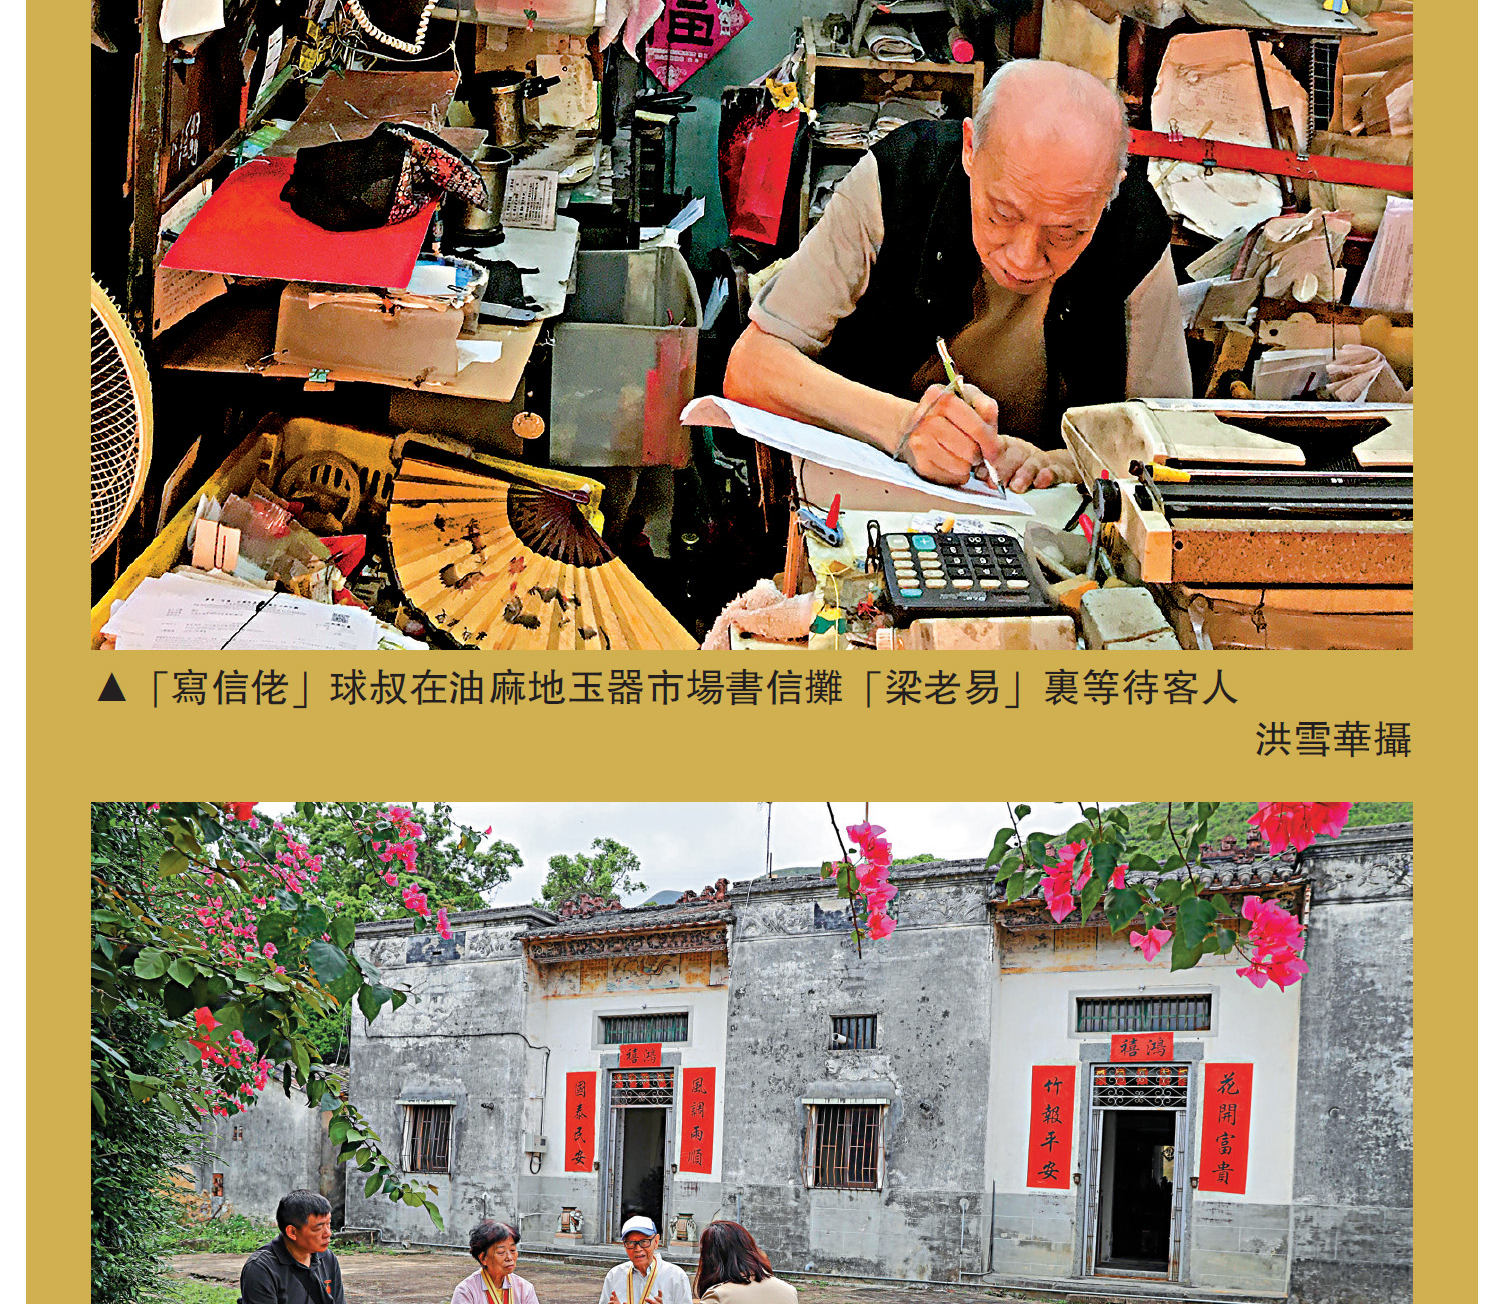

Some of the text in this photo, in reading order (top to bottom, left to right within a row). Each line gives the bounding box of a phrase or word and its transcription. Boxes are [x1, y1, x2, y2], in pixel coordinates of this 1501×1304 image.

[571, 1080, 588, 1165] 國泰民安
[688, 1077, 708, 1166] 風調雨順
[1037, 1076, 1063, 1181] 竹報平安
[1211, 1071, 1240, 1186] 花開富貴
